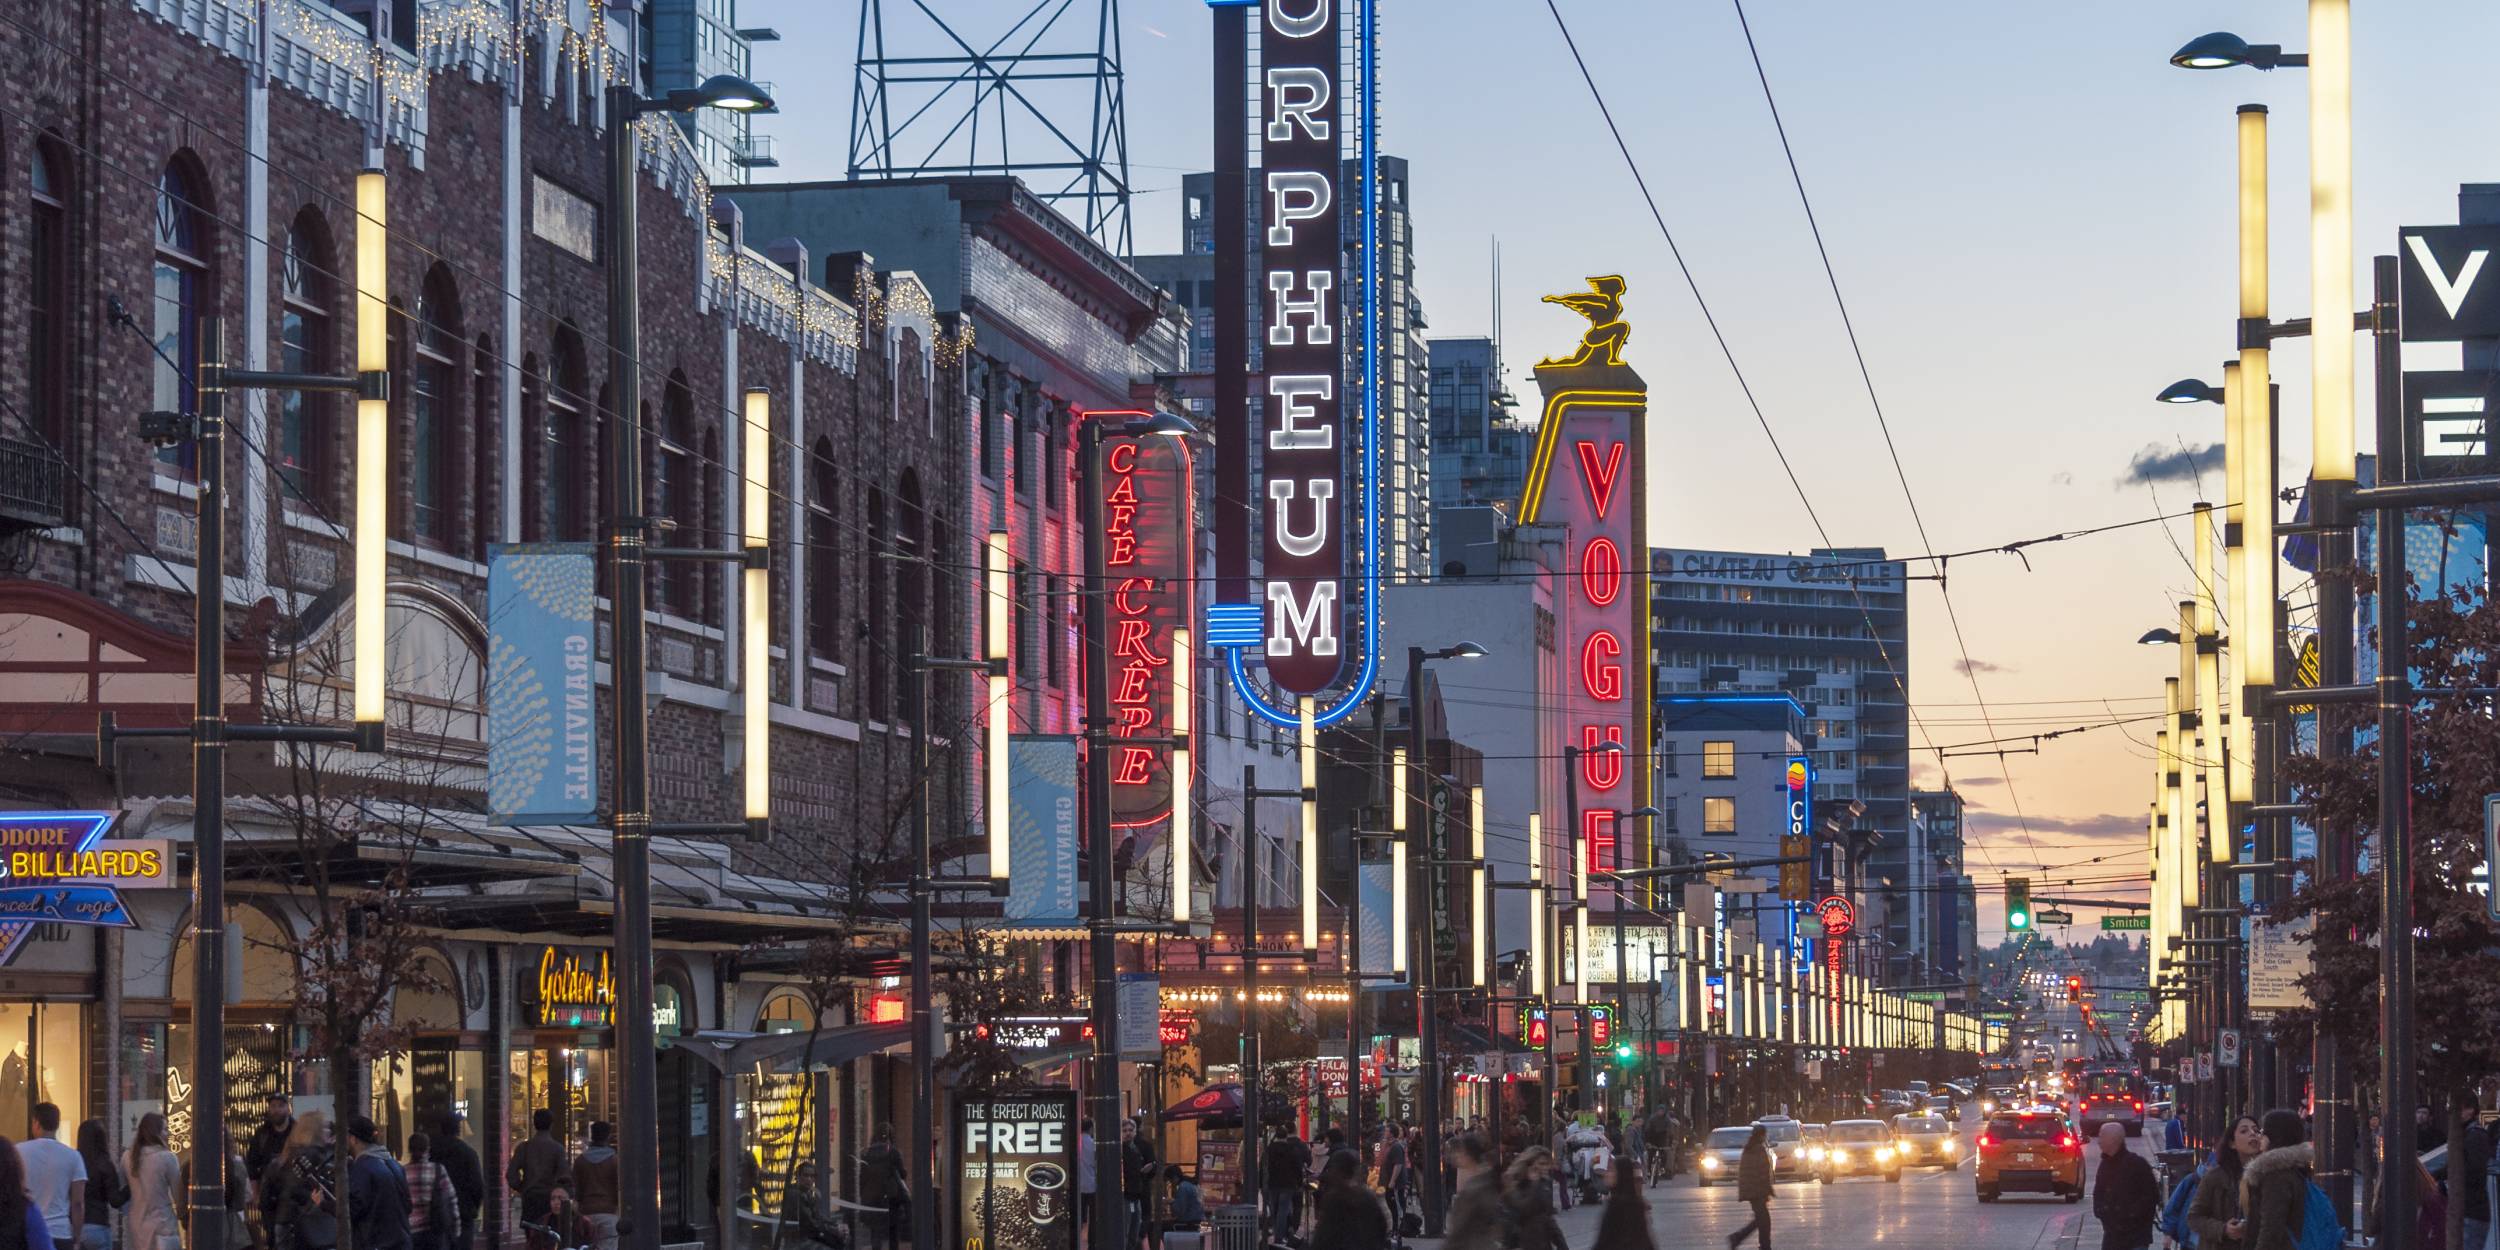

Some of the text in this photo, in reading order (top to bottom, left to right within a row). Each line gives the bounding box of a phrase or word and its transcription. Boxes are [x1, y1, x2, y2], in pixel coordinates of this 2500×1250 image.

[1683, 554, 1775, 581] CHATEAU
[1577, 440, 1623, 876] VOGUE
[12, 850, 161, 878] BILLIARDS
[2110, 918, 2146, 928] Smithe
[1230, 943, 1291, 953] SYPHONY
[1588, 939, 1609, 949] DOYLE
[1586, 949, 1604, 959] UGAR
[1586, 960, 1605, 970] AMES
[540, 946, 594, 1025] Golden
[965, 1103, 1066, 1119] THE ERFECT ROAST.
[966, 1121, 1064, 1154] FREE
[965, 1168, 981, 1178] FEB
[981, 1168, 1014, 1178] 2-MAR
